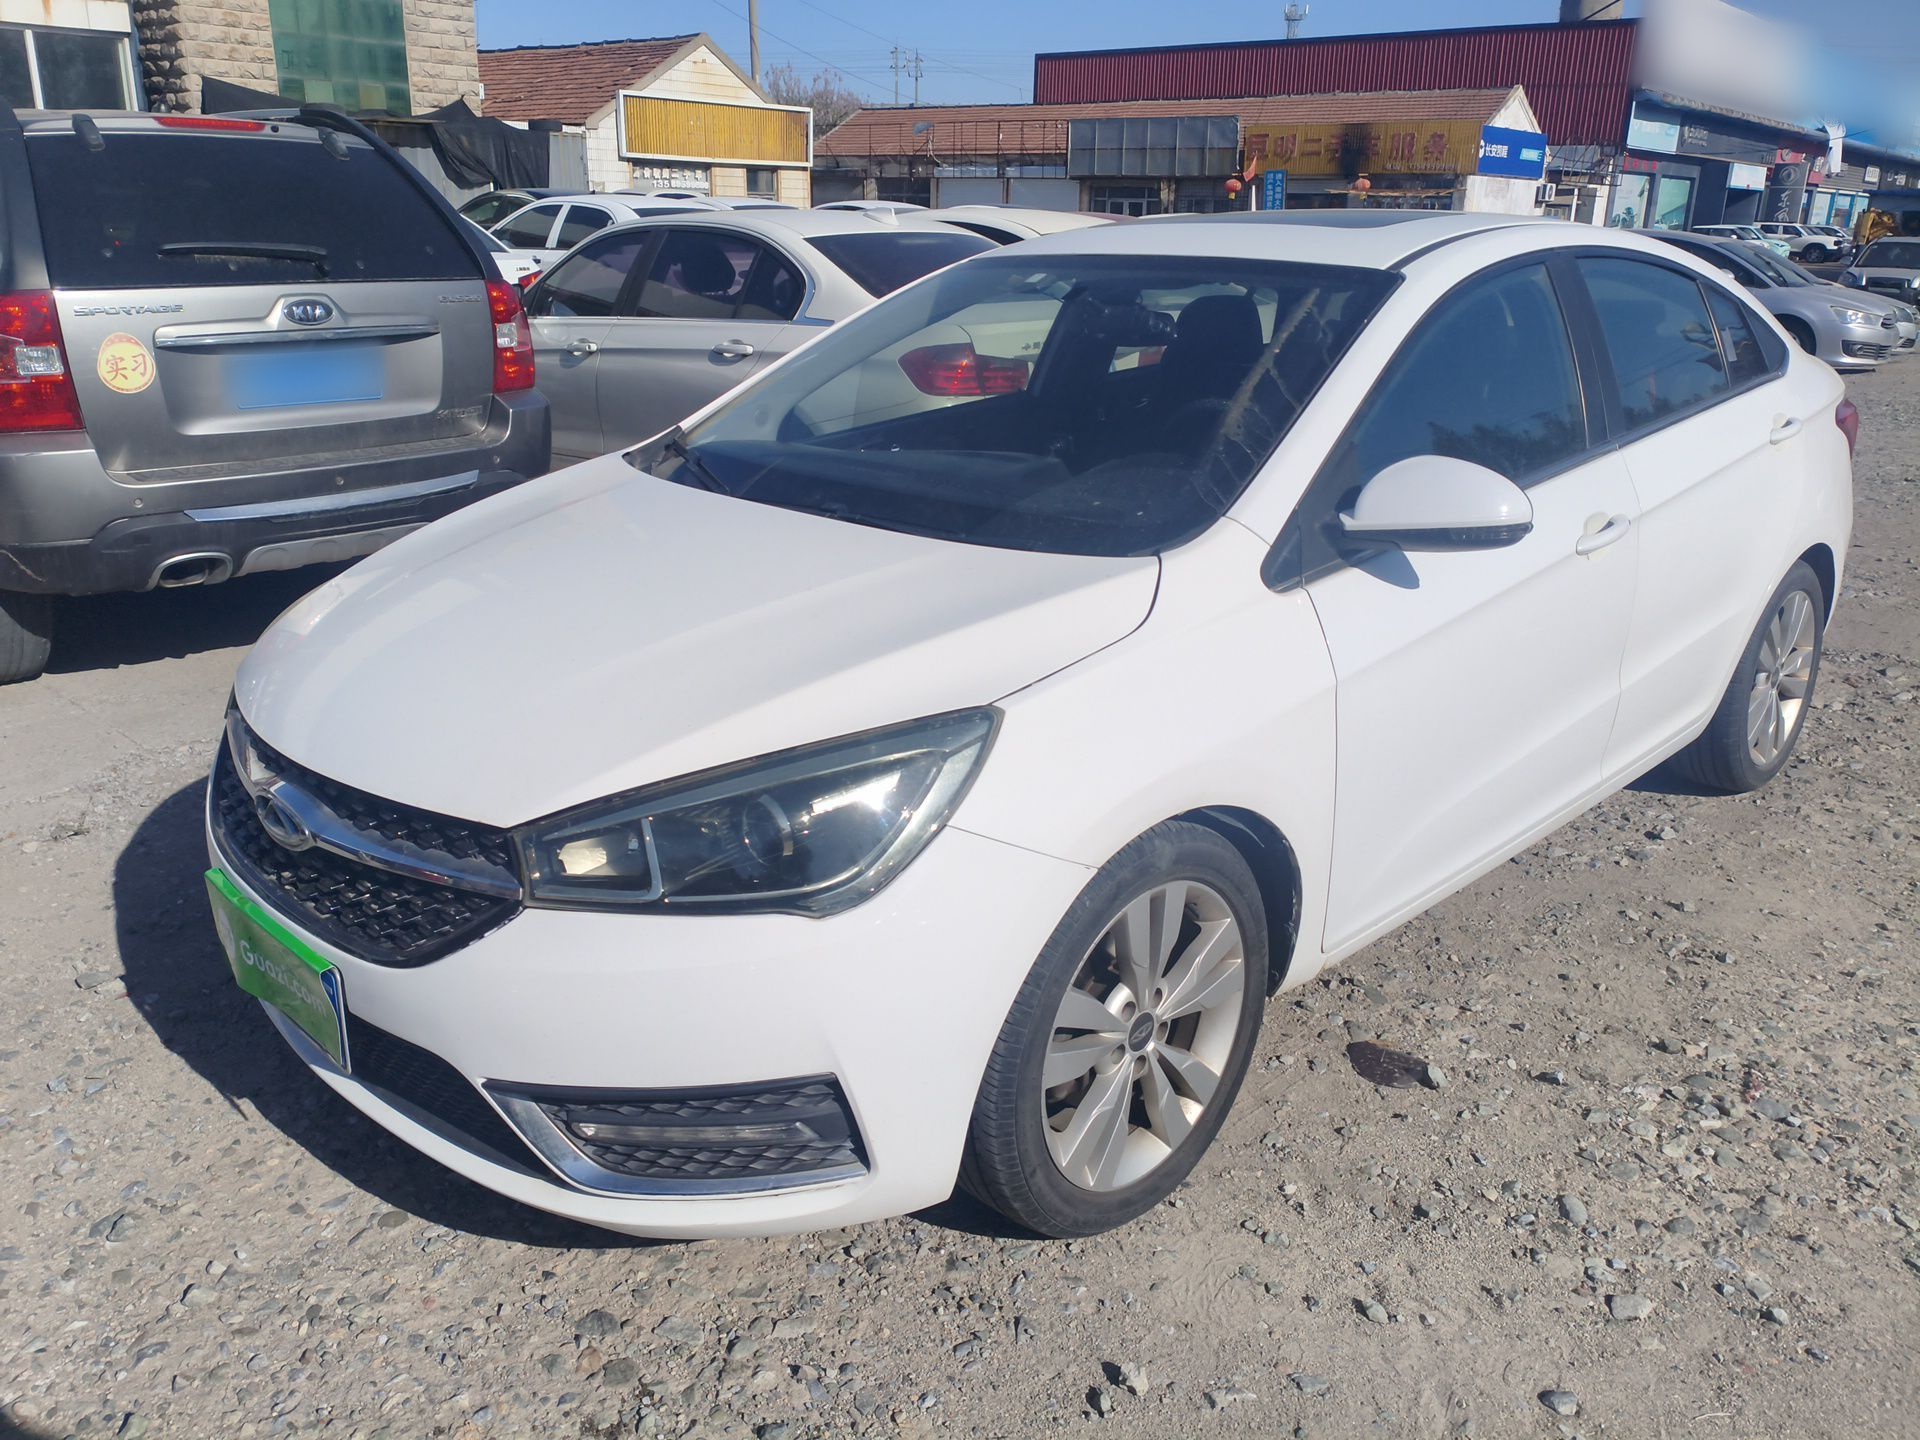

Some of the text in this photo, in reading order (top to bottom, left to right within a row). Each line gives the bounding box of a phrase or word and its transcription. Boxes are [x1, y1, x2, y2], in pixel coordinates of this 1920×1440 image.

[73, 303, 184, 317] SPORTAGE
[290, 304, 327, 321] KIA
[105, 353, 148, 382] 实习
[239, 940, 328, 1018] Guazi.com
